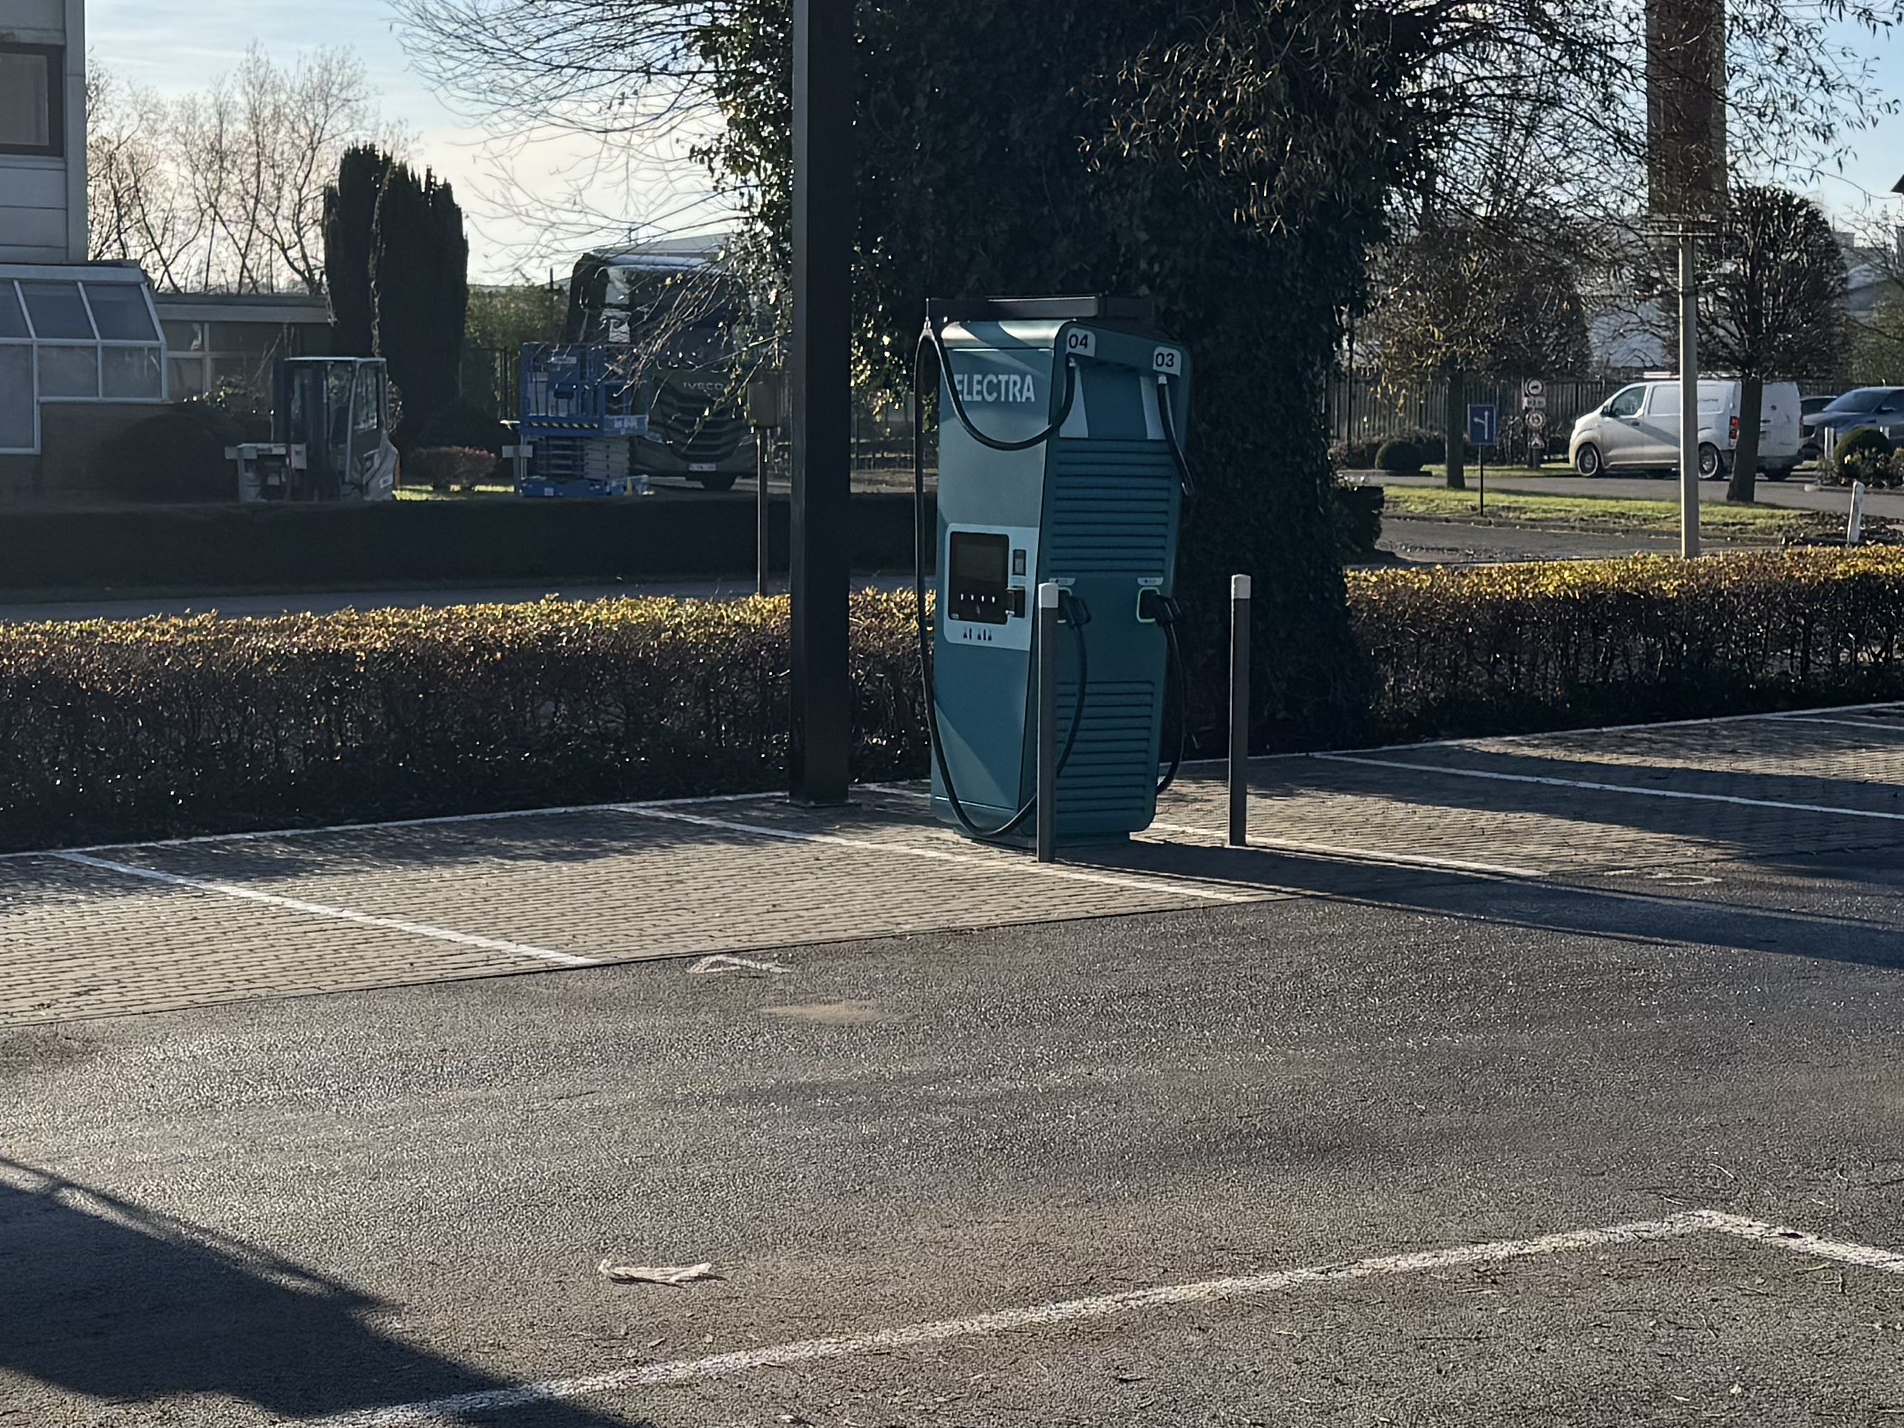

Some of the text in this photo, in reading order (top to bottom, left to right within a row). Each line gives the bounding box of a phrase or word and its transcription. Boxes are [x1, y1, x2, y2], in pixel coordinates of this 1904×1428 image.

[1068, 334, 1089, 349] 04
[1155, 352, 1175, 368] 03
[683, 382, 724, 391] IVECO
[954, 374, 1036, 403] ELECTRA
